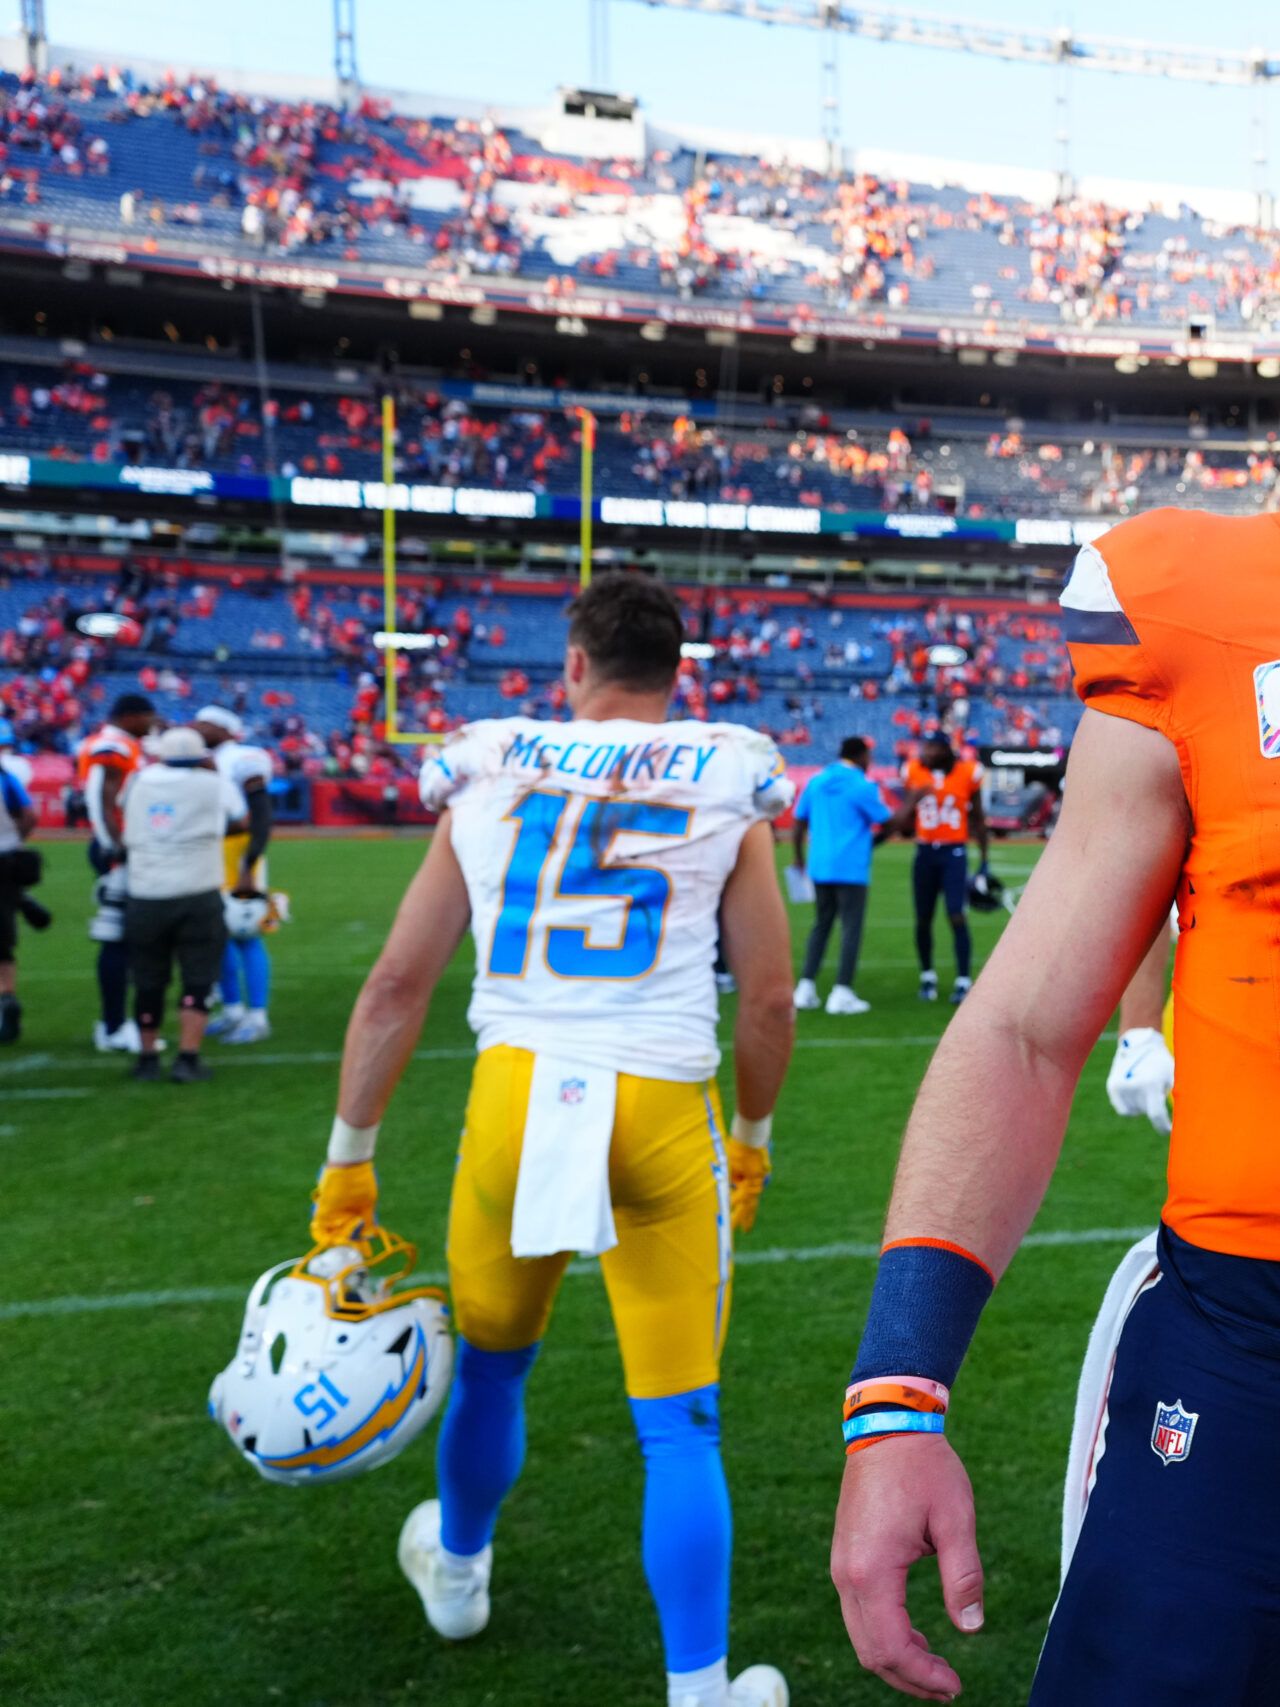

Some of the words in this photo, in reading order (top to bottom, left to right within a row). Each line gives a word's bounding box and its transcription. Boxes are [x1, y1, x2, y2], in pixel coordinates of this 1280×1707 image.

[487, 788, 696, 981] 15
[293, 1371, 349, 1430] 15
[1155, 1427, 1183, 1454] NFL
